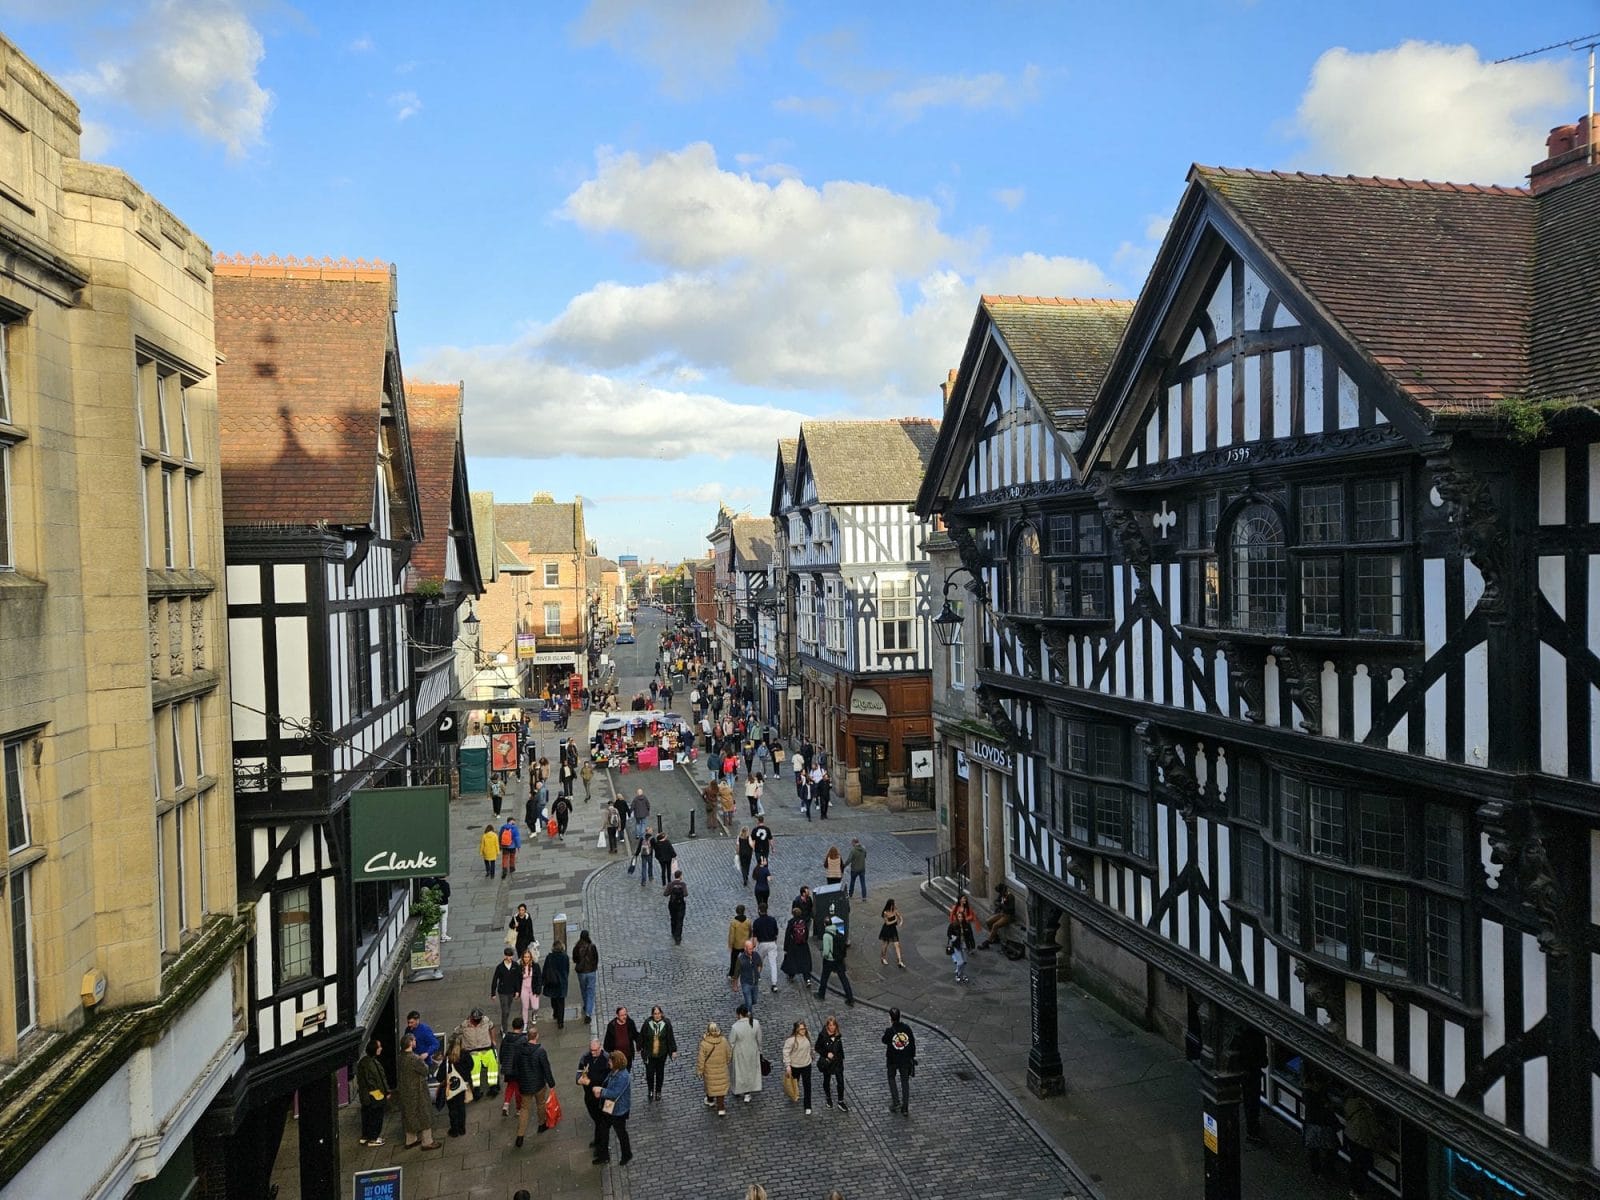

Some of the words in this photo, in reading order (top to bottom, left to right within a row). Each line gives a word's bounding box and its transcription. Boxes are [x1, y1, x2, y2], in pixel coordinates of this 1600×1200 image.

[1227, 447, 1250, 464] 1595
[492, 723, 517, 733] WHS
[973, 740, 1005, 766] LLOYDS
[364, 851, 437, 873] Clarks
[374, 1183, 394, 1195] ONE
